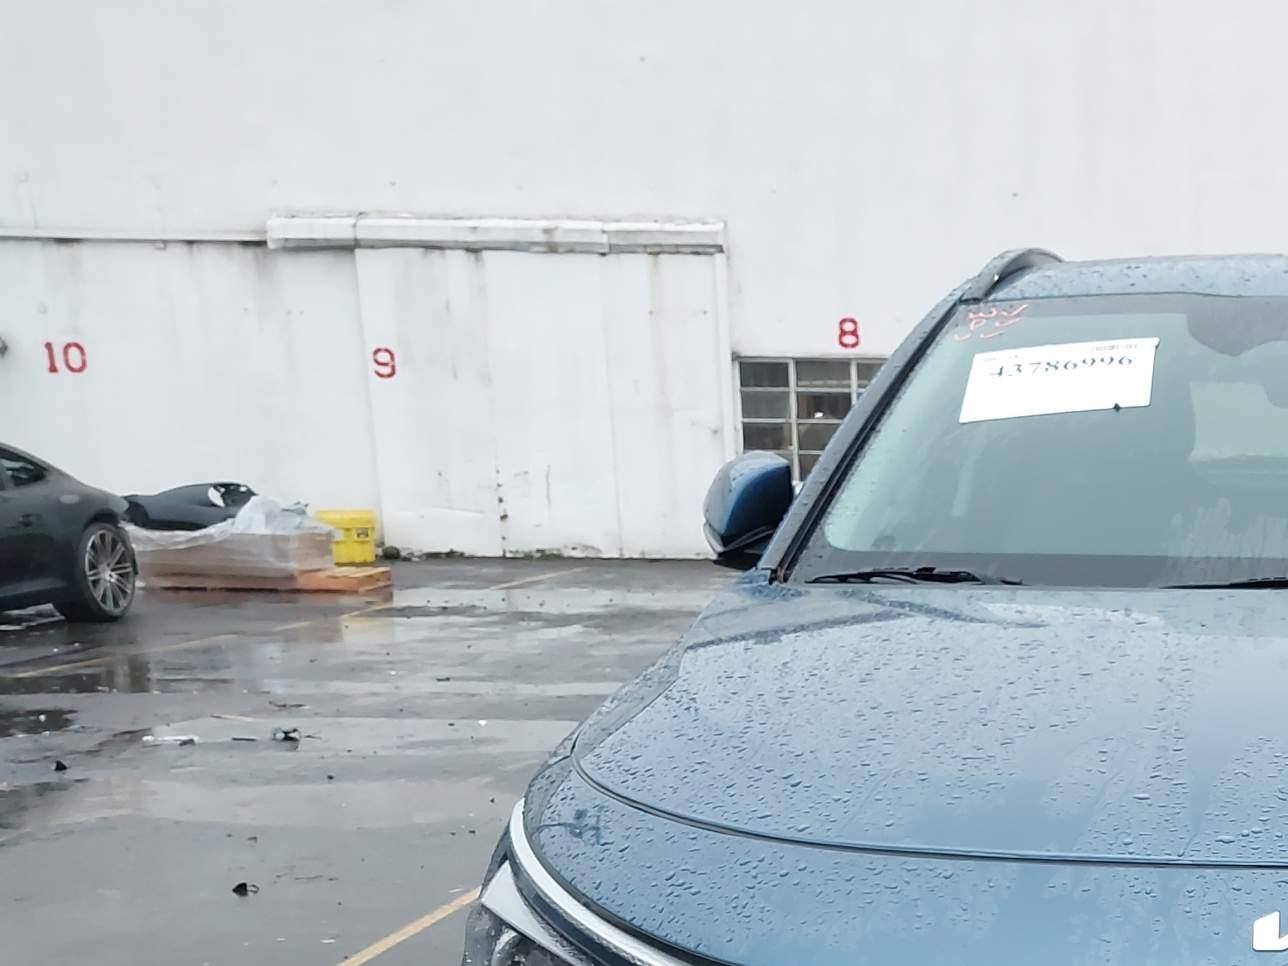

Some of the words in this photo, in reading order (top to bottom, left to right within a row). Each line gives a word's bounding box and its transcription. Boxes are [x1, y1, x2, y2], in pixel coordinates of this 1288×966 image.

[838, 318, 859, 349] 8
[45, 342, 88, 373] 10
[373, 347, 397, 378] 9
